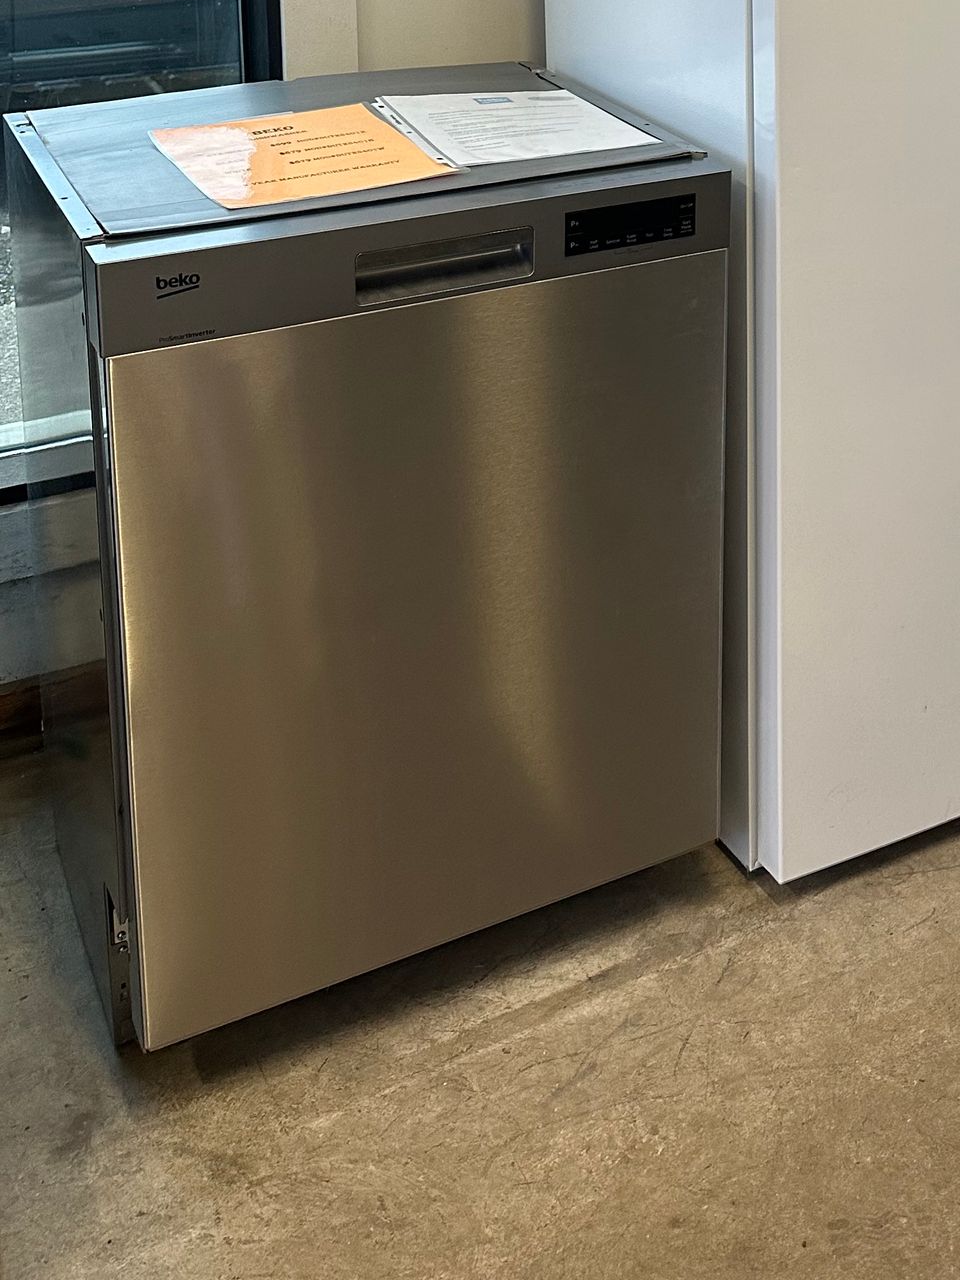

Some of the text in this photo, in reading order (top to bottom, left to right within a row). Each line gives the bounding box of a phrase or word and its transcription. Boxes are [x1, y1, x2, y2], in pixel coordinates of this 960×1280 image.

[251, 125, 294, 136] BEKO
[352, 159, 400, 170] WARRANTY
[155, 272, 200, 290] beko
